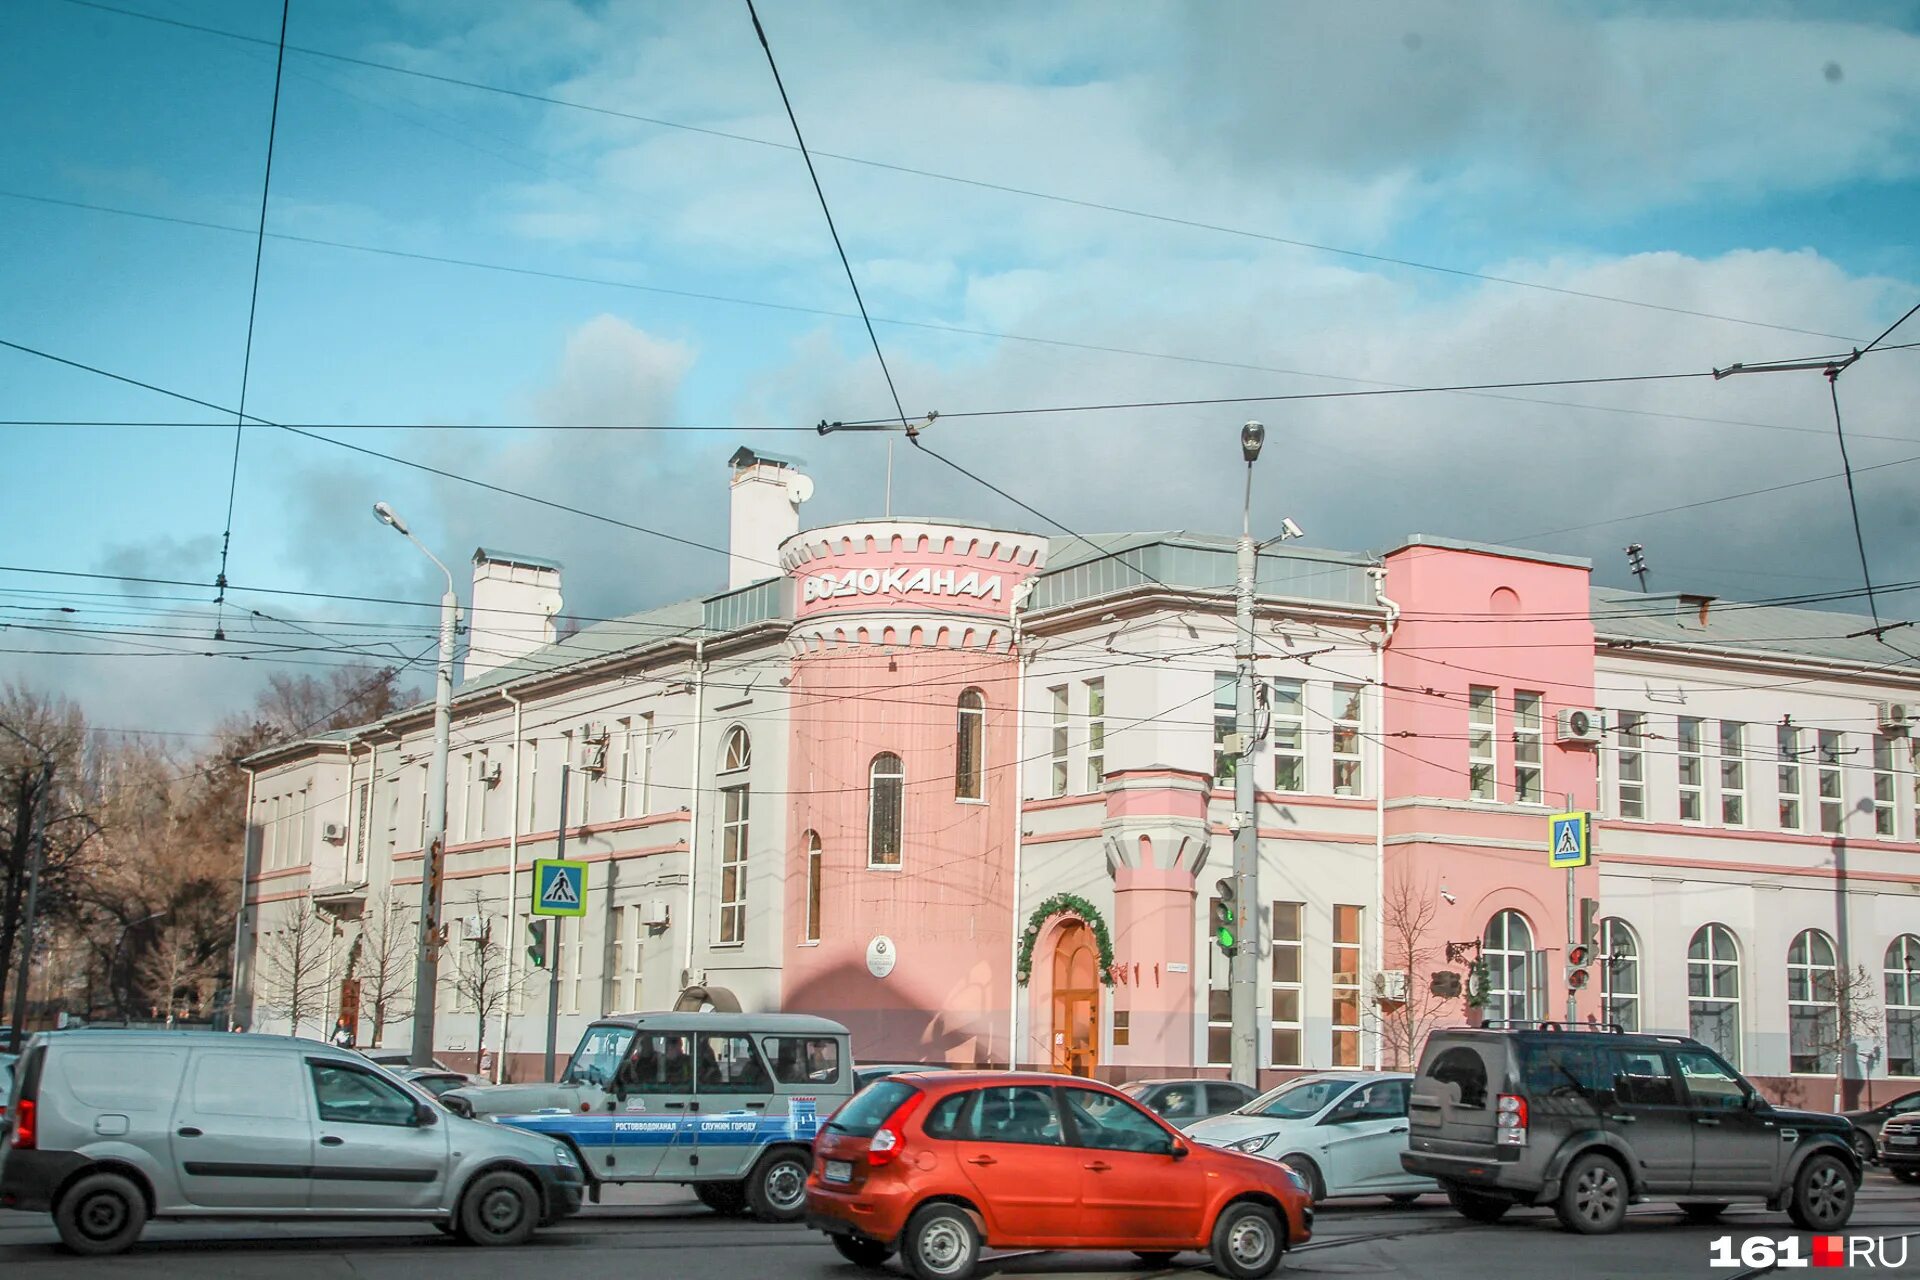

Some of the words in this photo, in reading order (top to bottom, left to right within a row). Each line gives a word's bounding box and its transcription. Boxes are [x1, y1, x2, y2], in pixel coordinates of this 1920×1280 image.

[804, 567, 1002, 603] ВОДОКАНАЛ
[615, 1122, 677, 1131] РОСТОВВОДОКАНАЛ
[701, 1122, 730, 1131] СЛУЖИМ
[731, 1122, 757, 1131] ГОРОДУ
